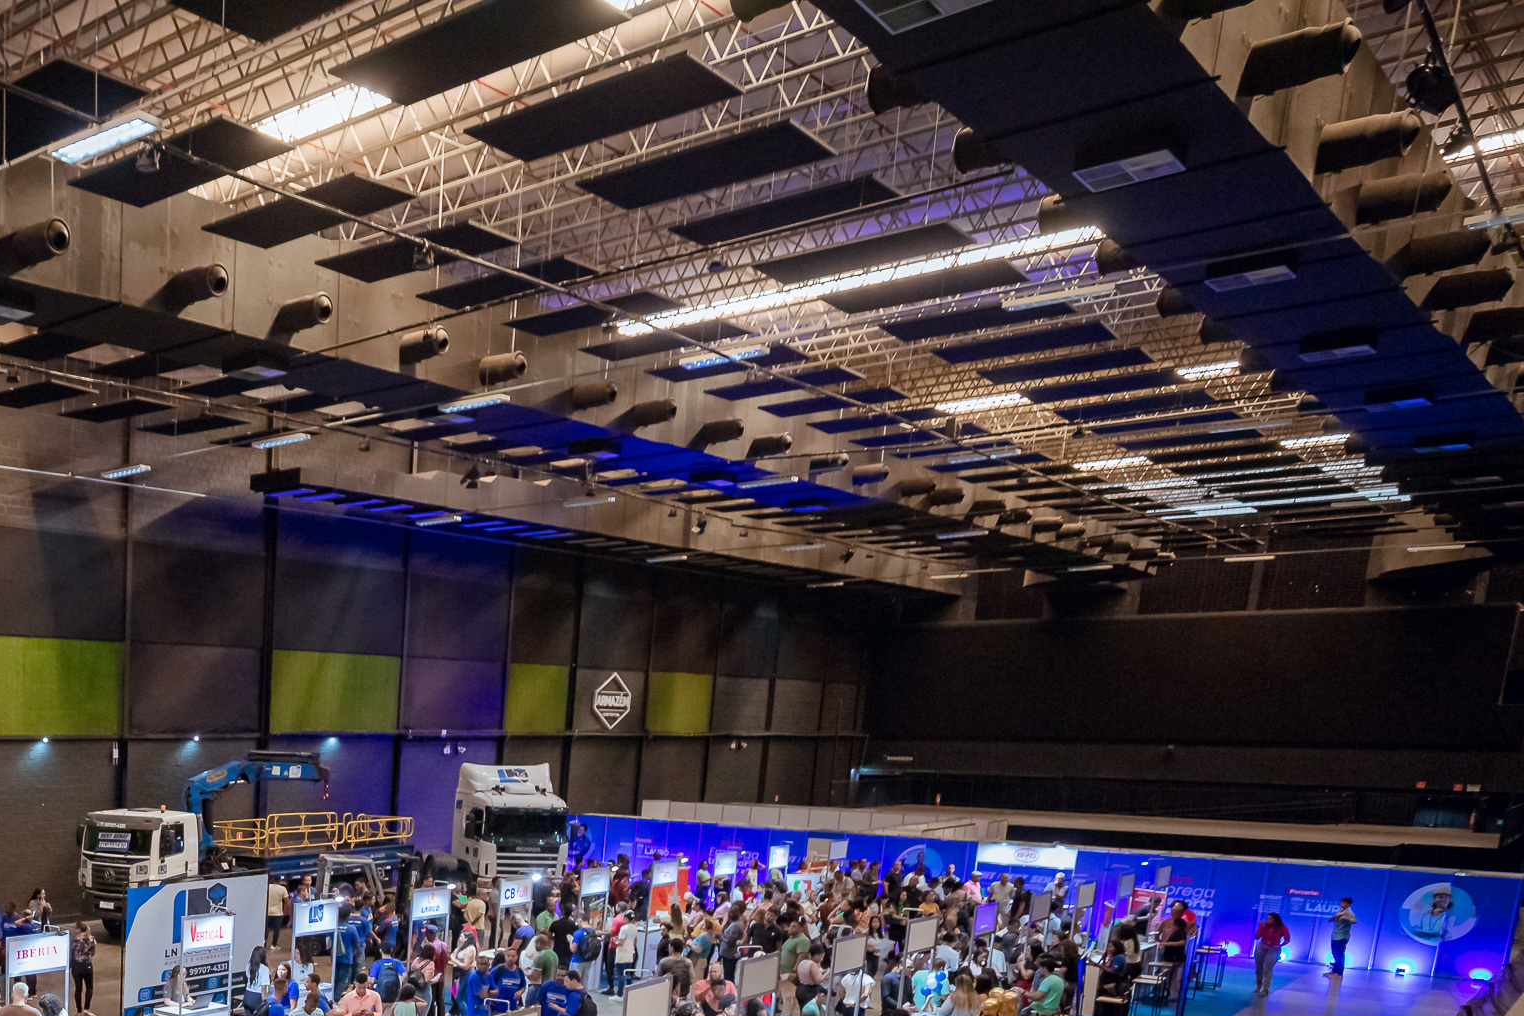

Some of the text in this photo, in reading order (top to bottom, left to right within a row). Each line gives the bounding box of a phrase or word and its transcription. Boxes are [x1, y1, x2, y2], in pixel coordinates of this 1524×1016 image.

[597, 693, 630, 707] ARMAZÉM
[420, 905, 440, 914] LARCO
[1305, 902, 1342, 914] LAUR
[190, 921, 224, 942] VERTICAL
[17, 945, 57, 960] IBÉRIA
[165, 948, 178, 958] LN
